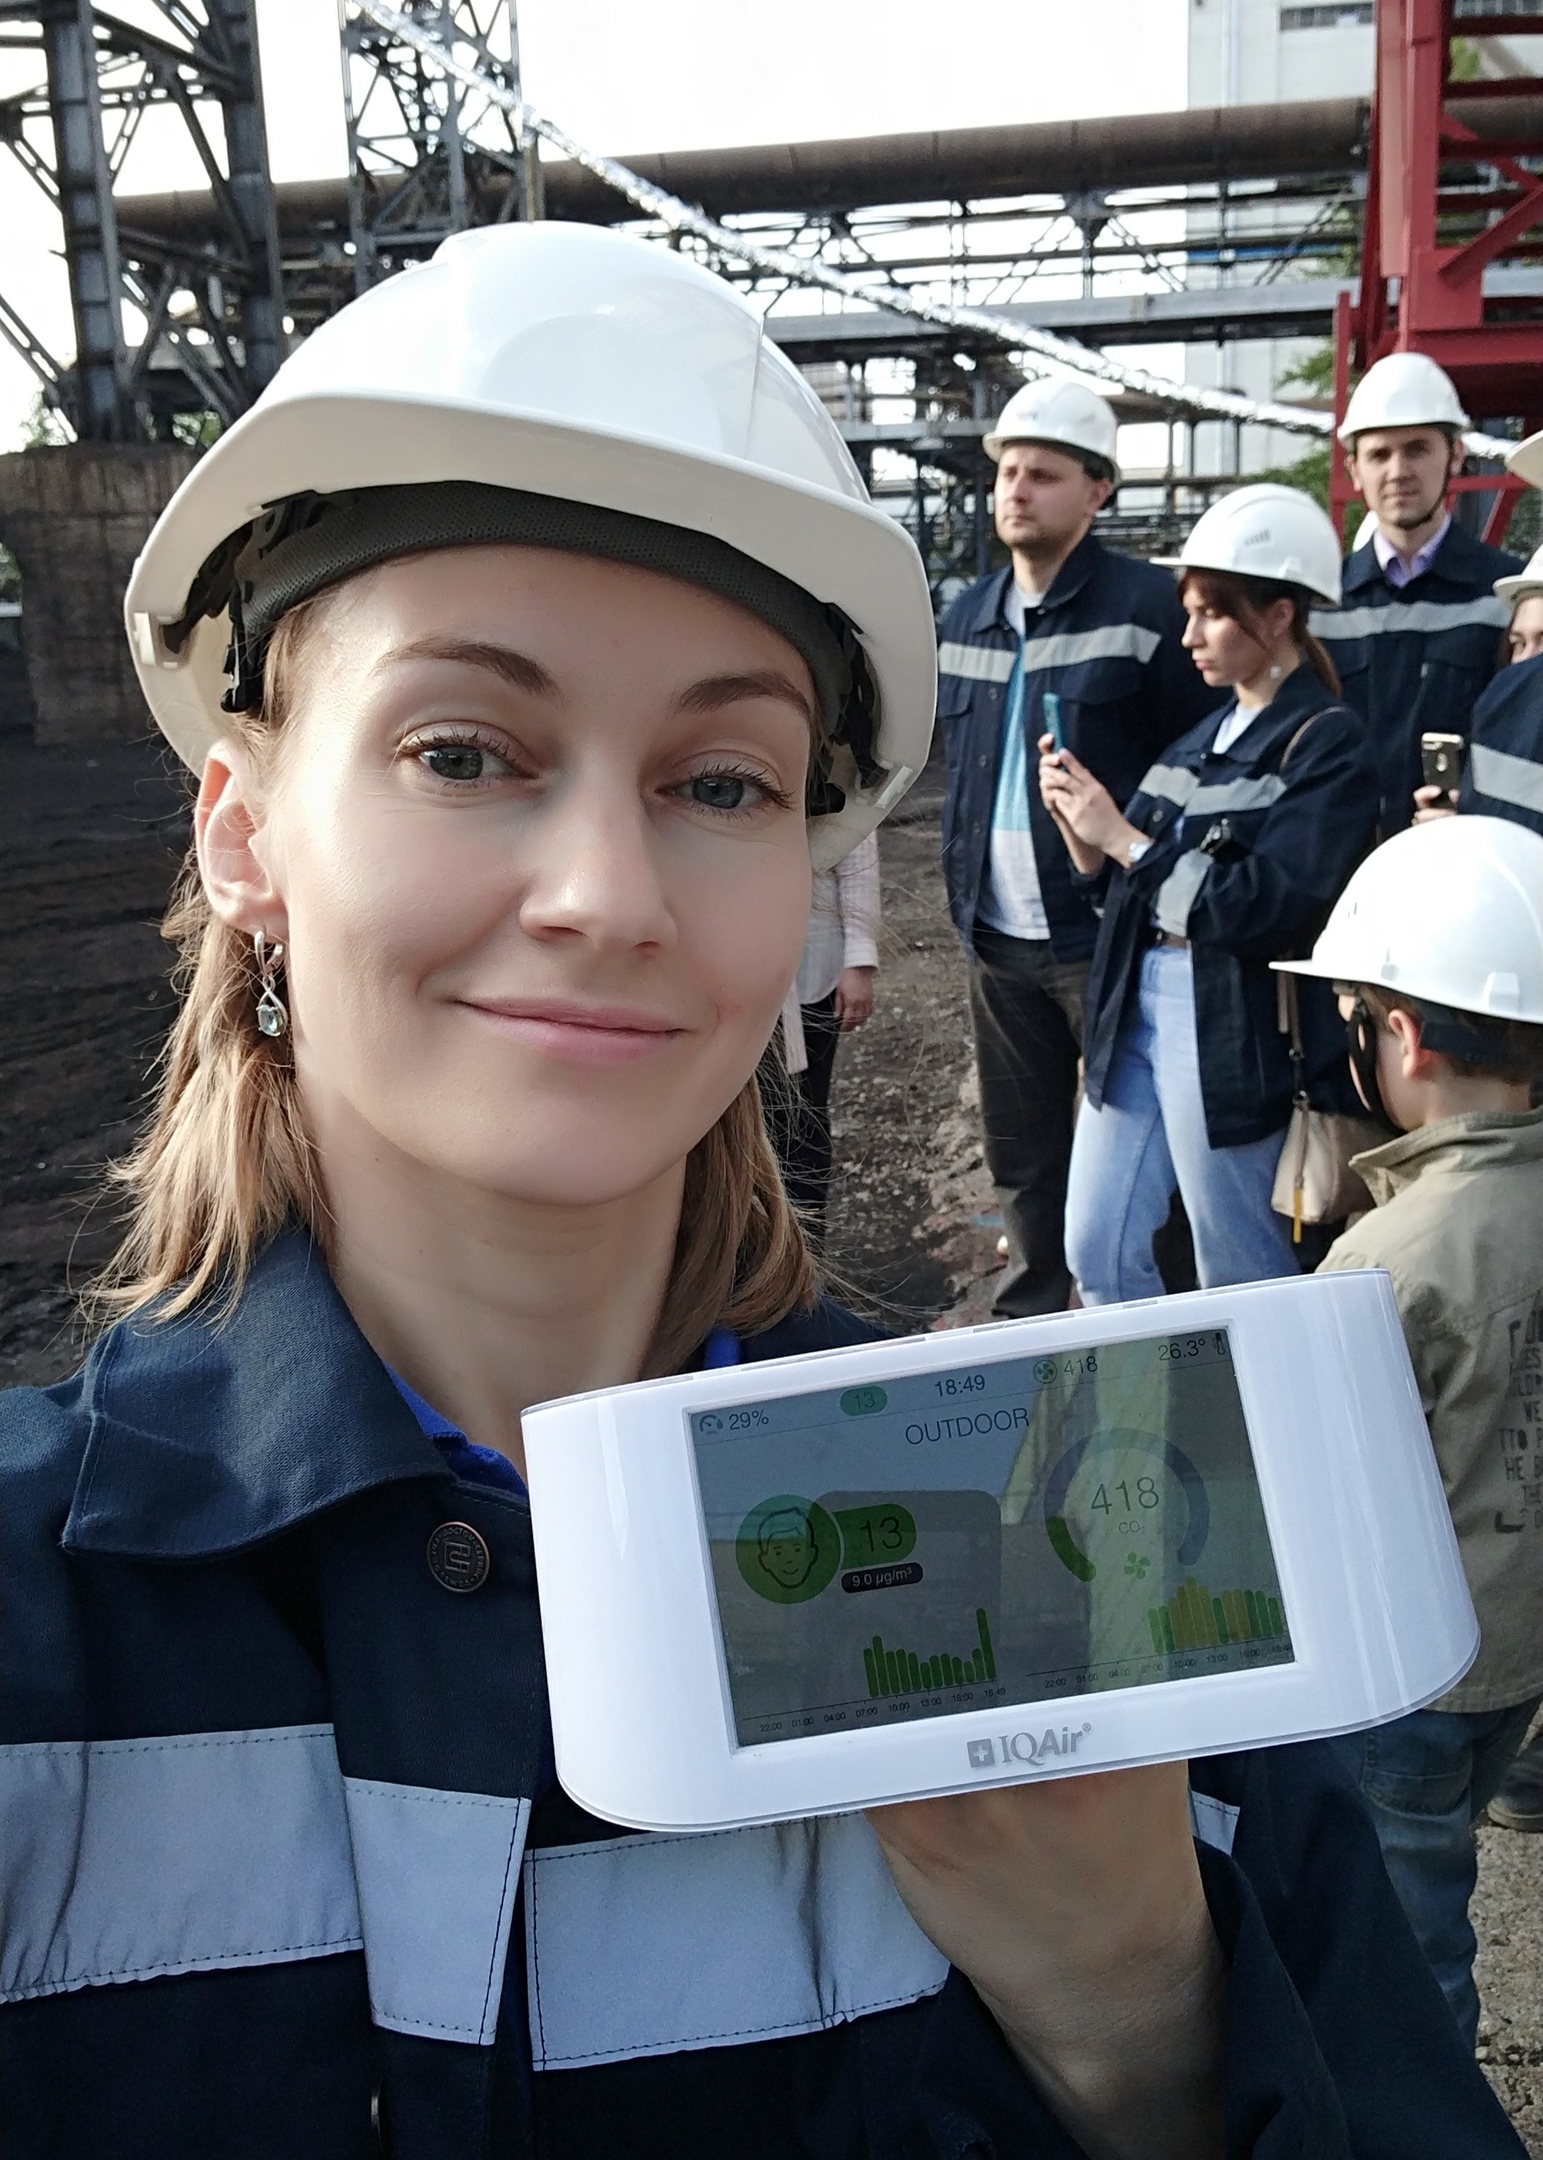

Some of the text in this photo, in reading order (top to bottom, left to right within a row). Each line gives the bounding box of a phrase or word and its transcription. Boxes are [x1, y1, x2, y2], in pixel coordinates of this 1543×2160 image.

[1158, 1337, 1206, 1361] 26.3°
[1063, 1355, 1099, 1376] 418
[934, 1374, 986, 1398] 18:49
[853, 1391, 876, 1409] 13
[728, 1409, 770, 1431] 29%
[905, 1407, 1030, 1446] OUTDOOR
[1090, 1476, 1160, 1516] 418
[859, 1516, 903, 1552] 13
